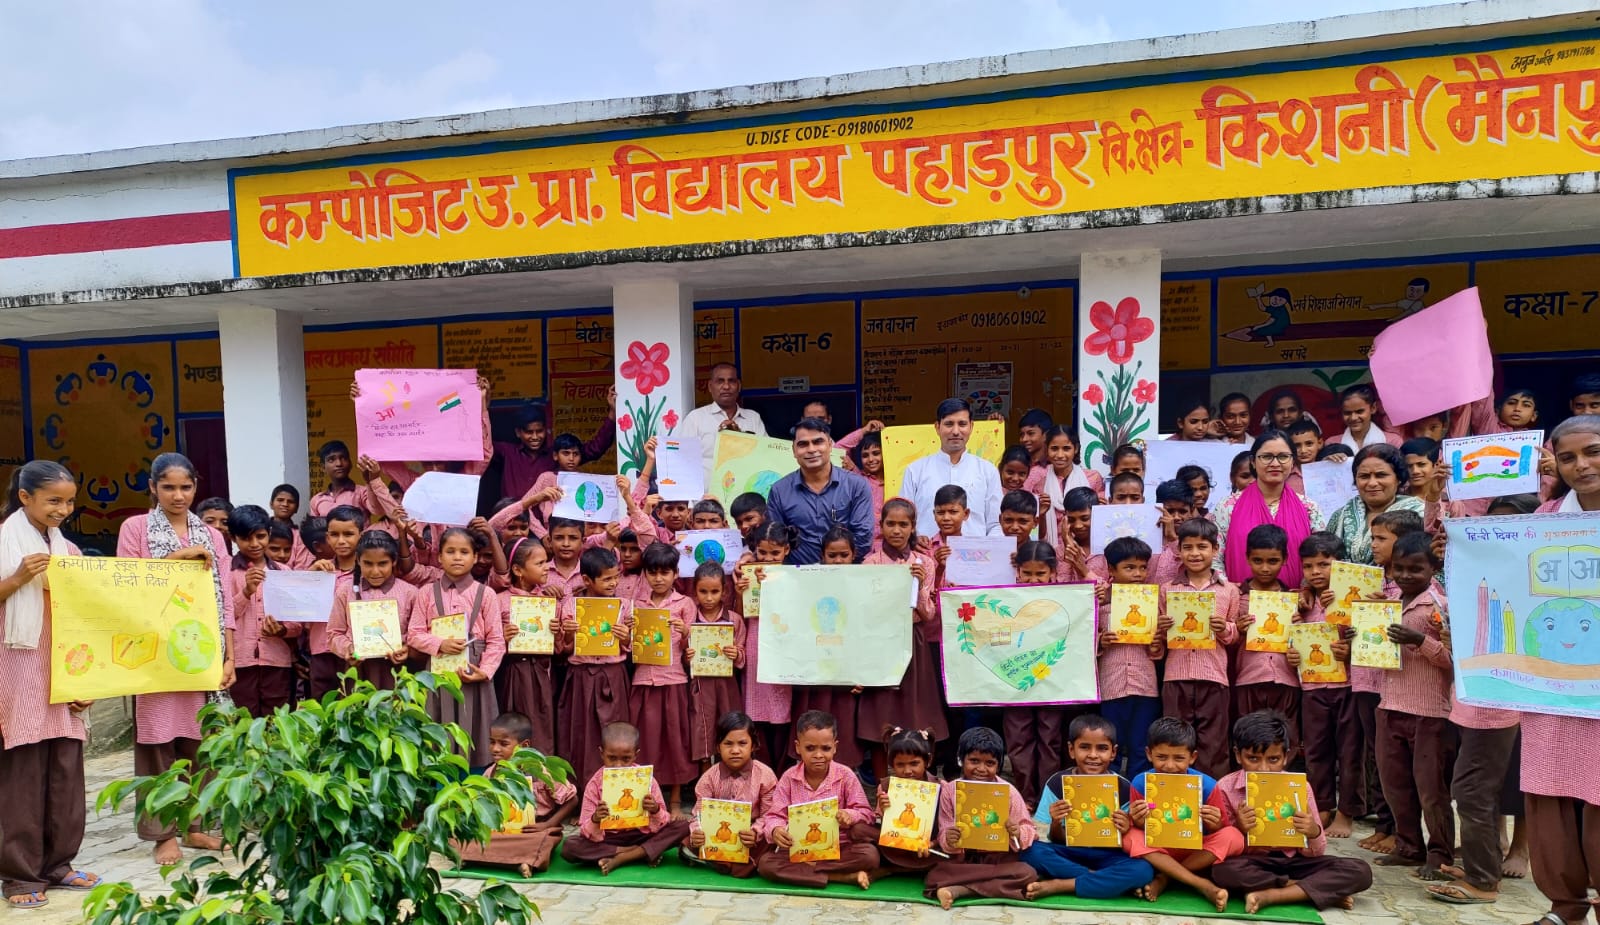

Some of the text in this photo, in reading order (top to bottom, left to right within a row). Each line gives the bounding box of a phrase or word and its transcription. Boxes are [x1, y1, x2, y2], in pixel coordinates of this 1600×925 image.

[258, 168, 471, 248] कम्पोजिट
[608, 144, 851, 221] विद्यालय
[860, 120, 1099, 208] पहाड़पुर
[576, 321, 603, 343] बेटी
[561, 381, 610, 401] विद्याल
[1535, 560, 1562, 582] अ
